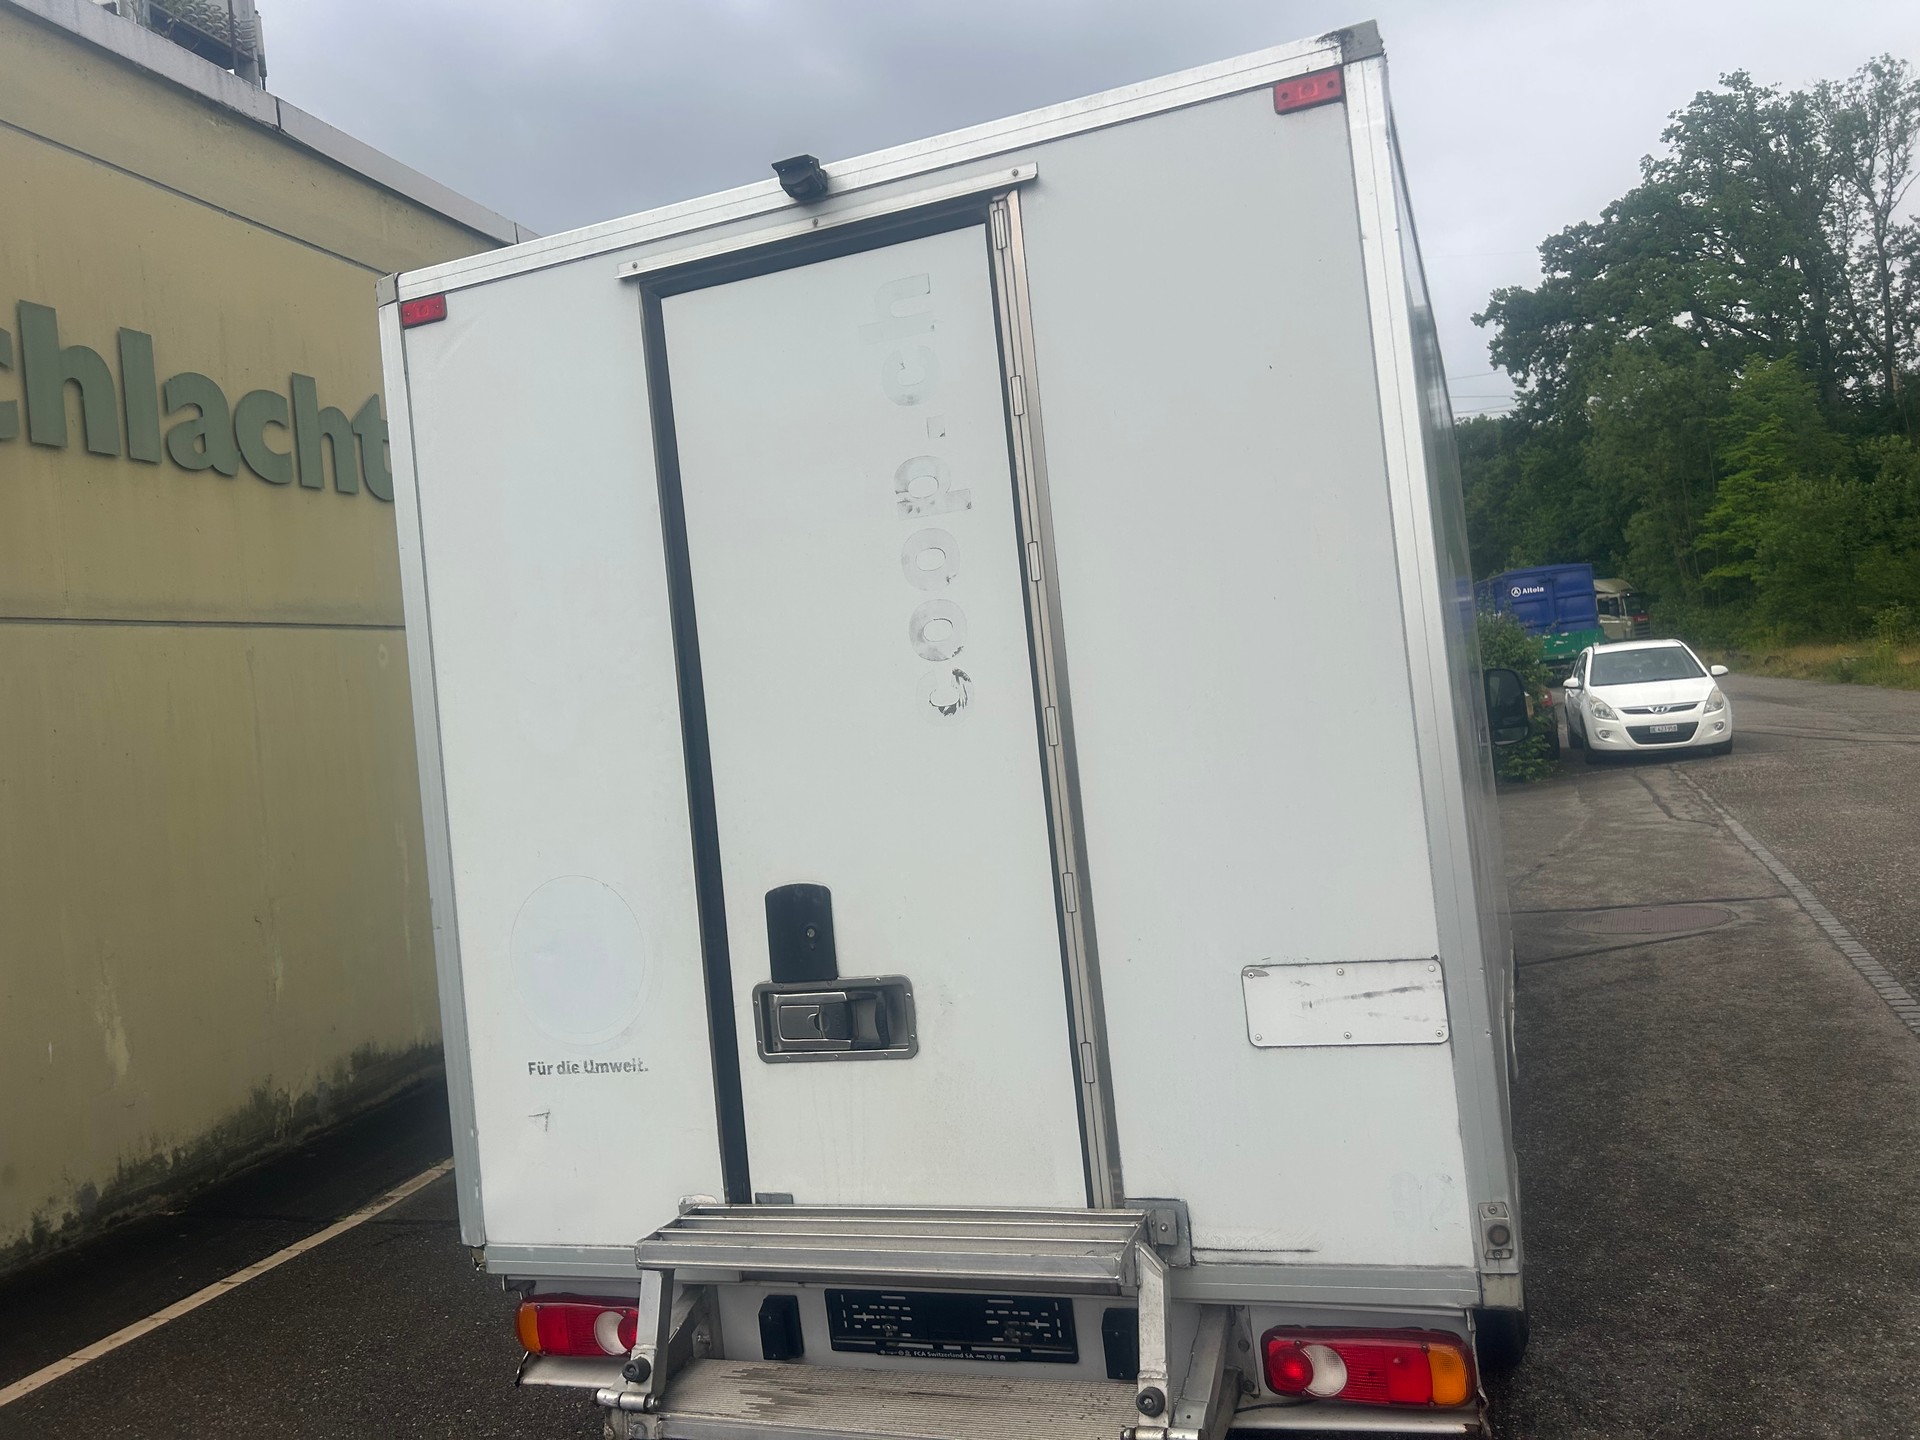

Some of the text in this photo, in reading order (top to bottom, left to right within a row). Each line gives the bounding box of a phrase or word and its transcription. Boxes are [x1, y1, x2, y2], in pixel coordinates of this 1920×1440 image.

[858, 273, 976, 727] coop.ch
[528, 1061, 553, 1076] Für
[556, 1060, 580, 1075] die
[927, 1351, 964, 1359] Switzerland
